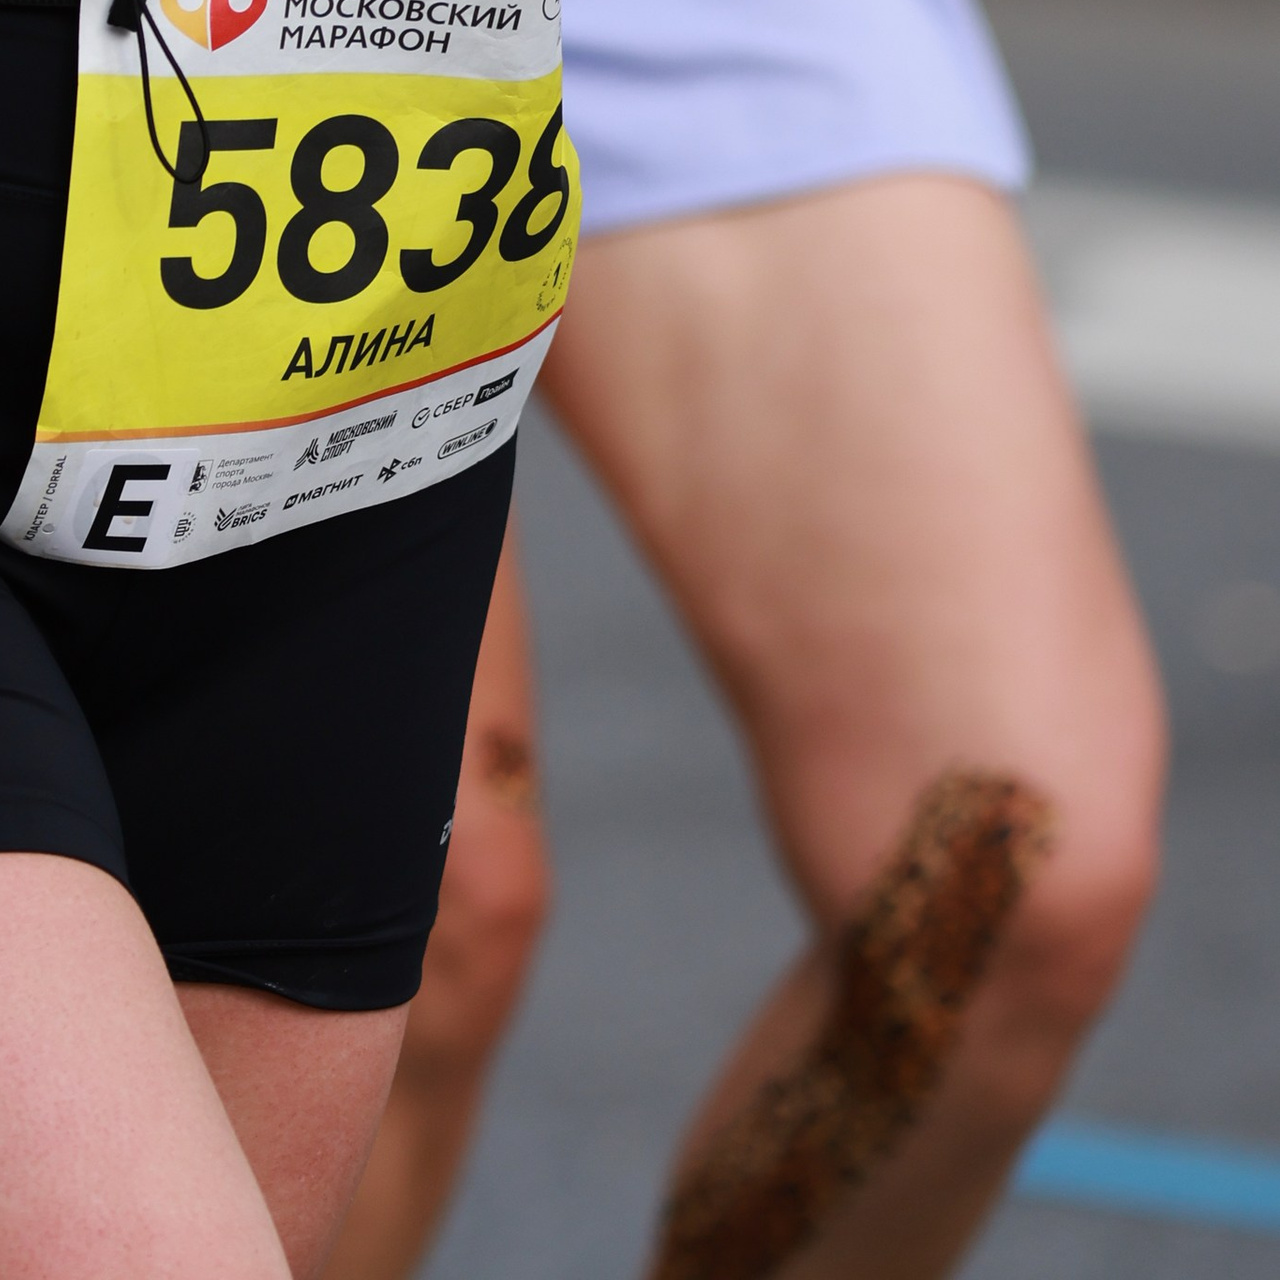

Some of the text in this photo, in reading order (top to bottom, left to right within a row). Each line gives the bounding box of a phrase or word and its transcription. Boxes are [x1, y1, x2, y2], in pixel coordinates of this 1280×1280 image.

[278, 25, 453, 54] МАРАФОН
[159, 99, 570, 310] 5838
[280, 313, 436, 382] АЛИНА
[433, 379, 511, 418] СБЕР Прайм
[325, 409, 399, 447] МОСКОВСКИЙ
[441, 426, 486, 456] WINLINE
[217, 453, 275, 469] Департамент
[319, 438, 356, 463] СПОРТ
[211, 471, 274, 490] города Москвы
[215, 468, 245, 479] спорта
[22, 502, 49, 542] КЛАСТЕР
[45, 454, 68, 495] CORRAL
[81, 463, 172, 553] E
[230, 507, 269, 529] BRICS
